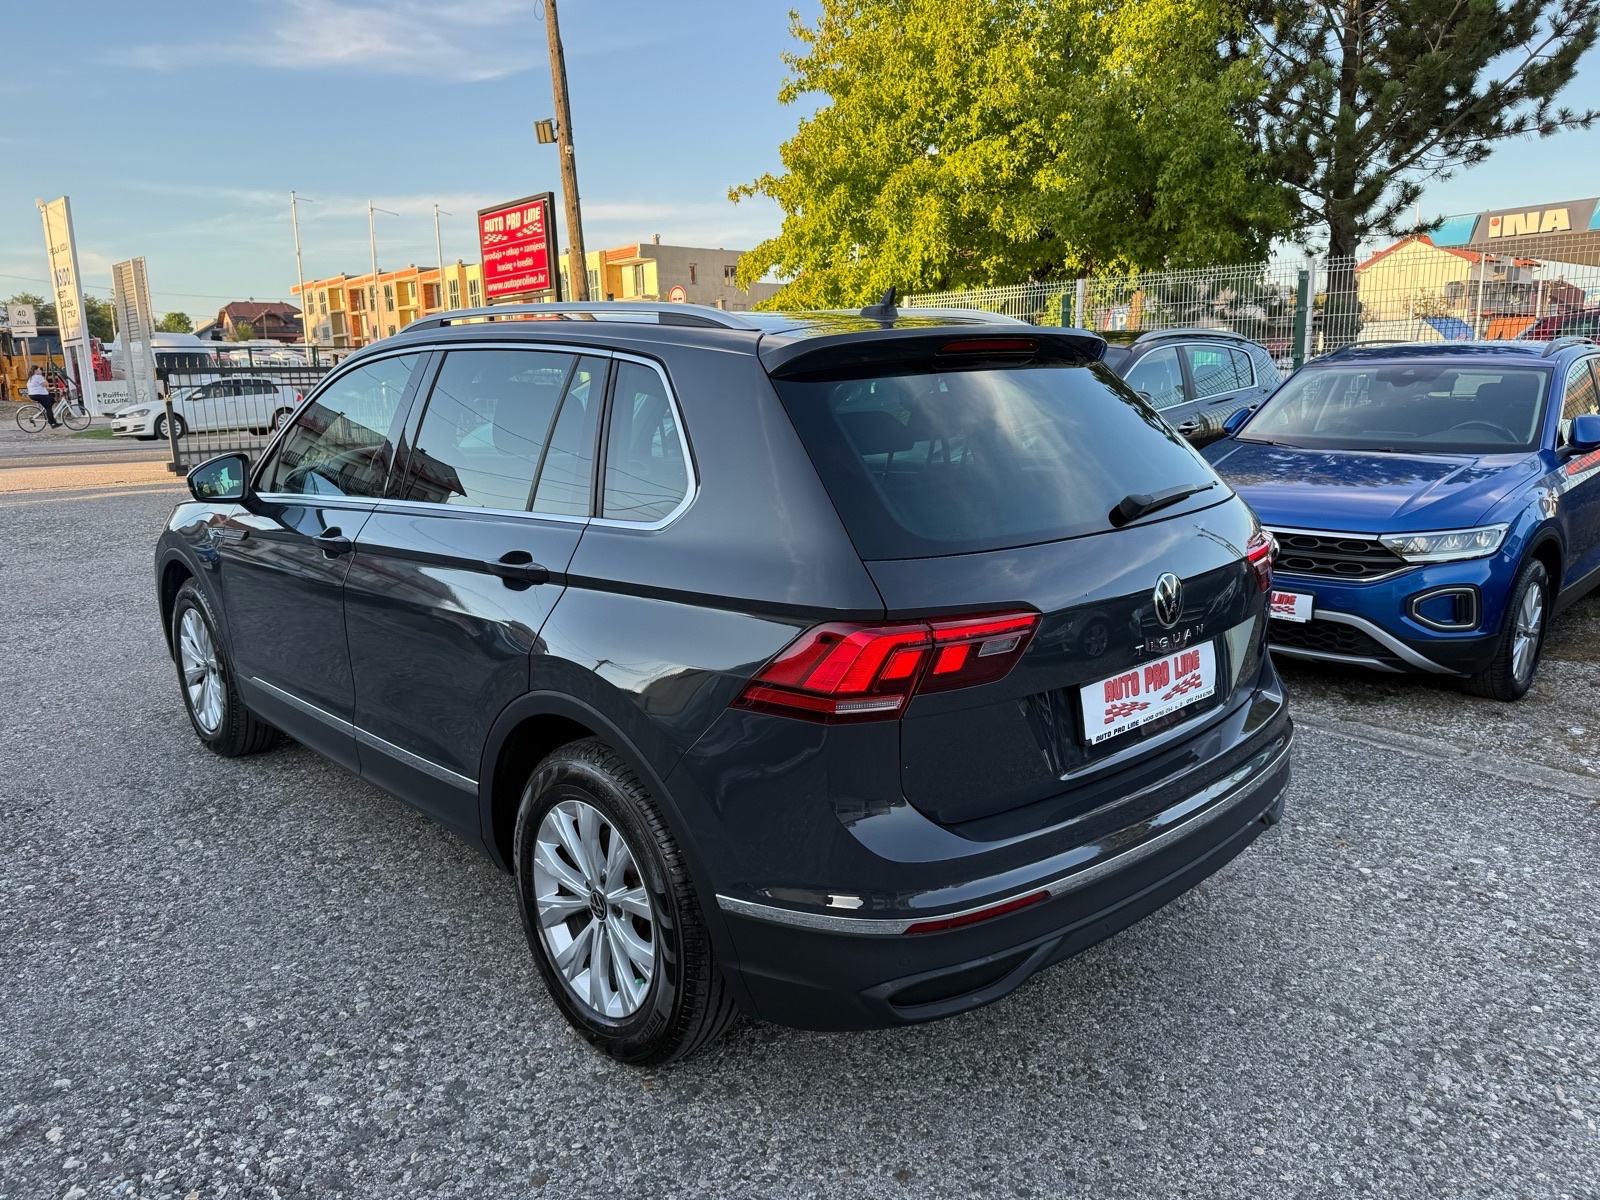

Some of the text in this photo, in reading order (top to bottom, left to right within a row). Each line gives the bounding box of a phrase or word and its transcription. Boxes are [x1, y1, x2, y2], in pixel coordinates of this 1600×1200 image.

[484, 207, 541, 232] AUTO PRO LINE
[484, 242, 546, 262] prodaja otkup zamjena
[497, 256, 534, 272] leasing krediti
[488, 273, 545, 291] www.autoproline.hr
[1135, 623, 1204, 656] TIGUAN
[1104, 649, 1200, 703] AUTO PRO LINE
[1096, 731, 1112, 742] AUTO
[1113, 725, 1126, 736] PRO
[1127, 719, 1140, 730] LINE
